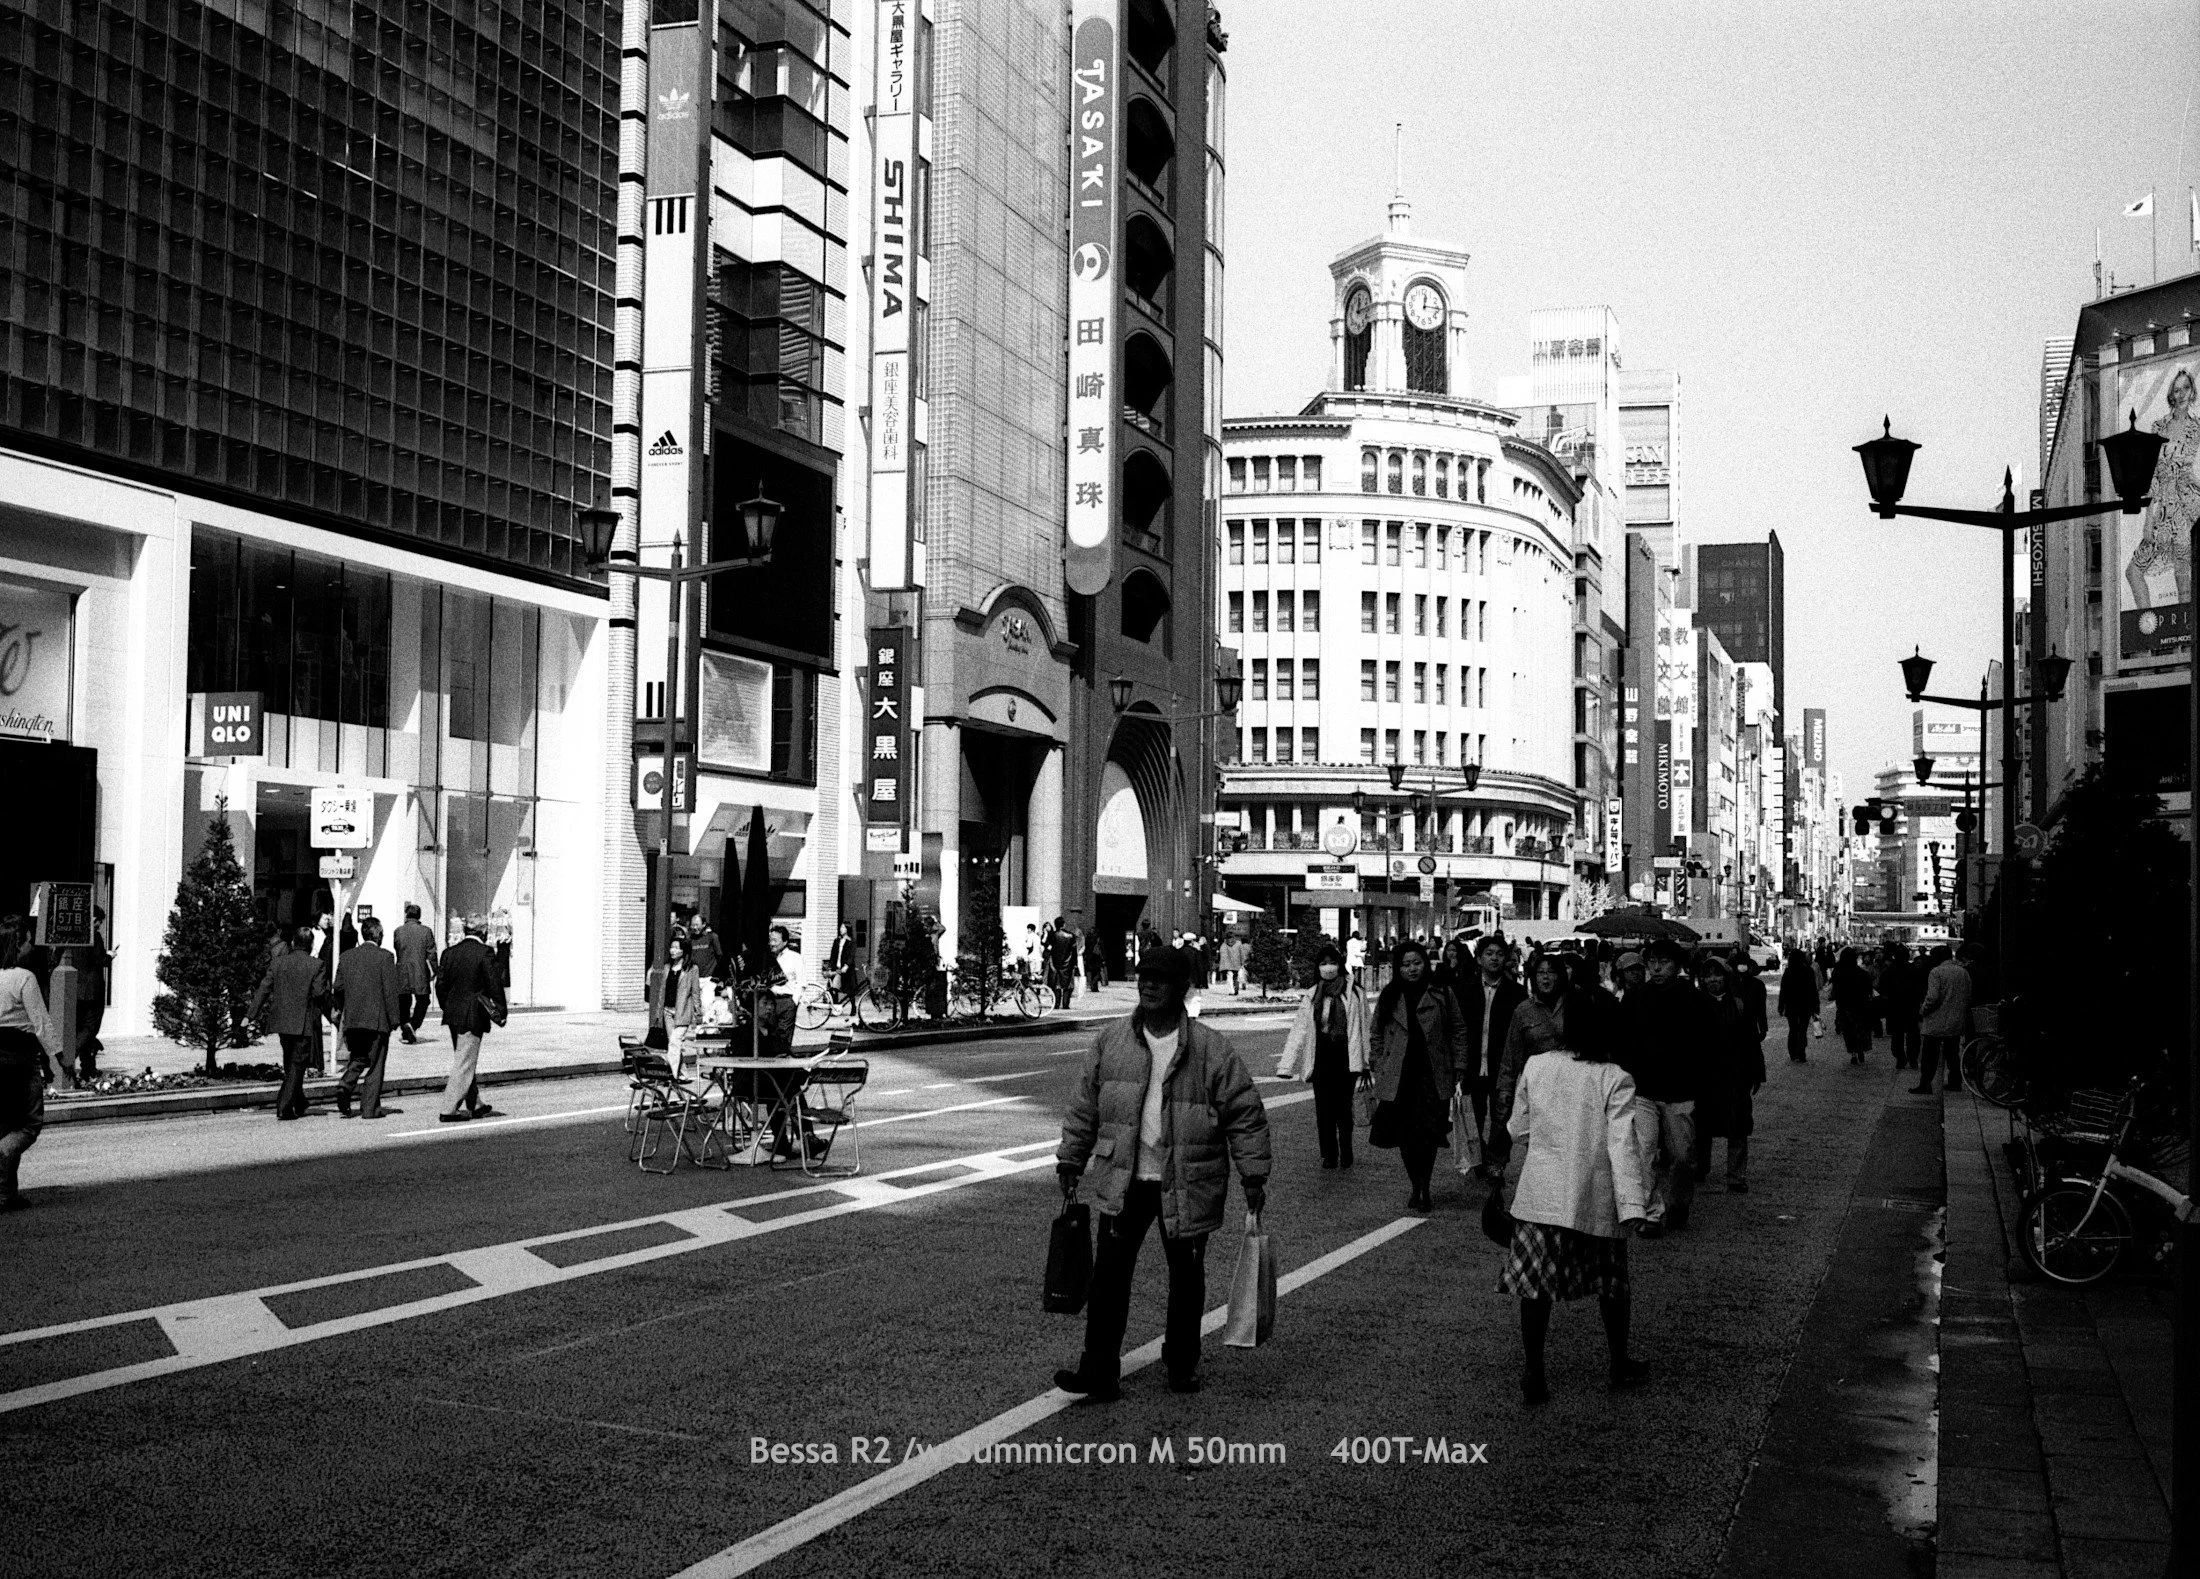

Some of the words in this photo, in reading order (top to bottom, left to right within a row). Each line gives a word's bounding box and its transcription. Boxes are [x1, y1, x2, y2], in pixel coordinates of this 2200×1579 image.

[890, 1, 905, 111] 大黒屋ギャラリー
[1074, 59, 1105, 207] TASAKI
[883, 158, 904, 318] SHIMA
[648, 446, 683, 456] adidas
[1075, 317, 1105, 509] 田崎真珠
[2032, 496, 2043, 587] MSUKOSHI
[213, 705, 250, 722] UNI
[1674, 626, 1689, 714] 教文館
[211, 725, 250, 742] QLO
[872, 648, 898, 801] 銀座大黒屋
[1658, 743, 1669, 810] MIKIMOTO
[58, 896, 84, 911] 銀座
[58, 912, 82, 925] 5丁目
